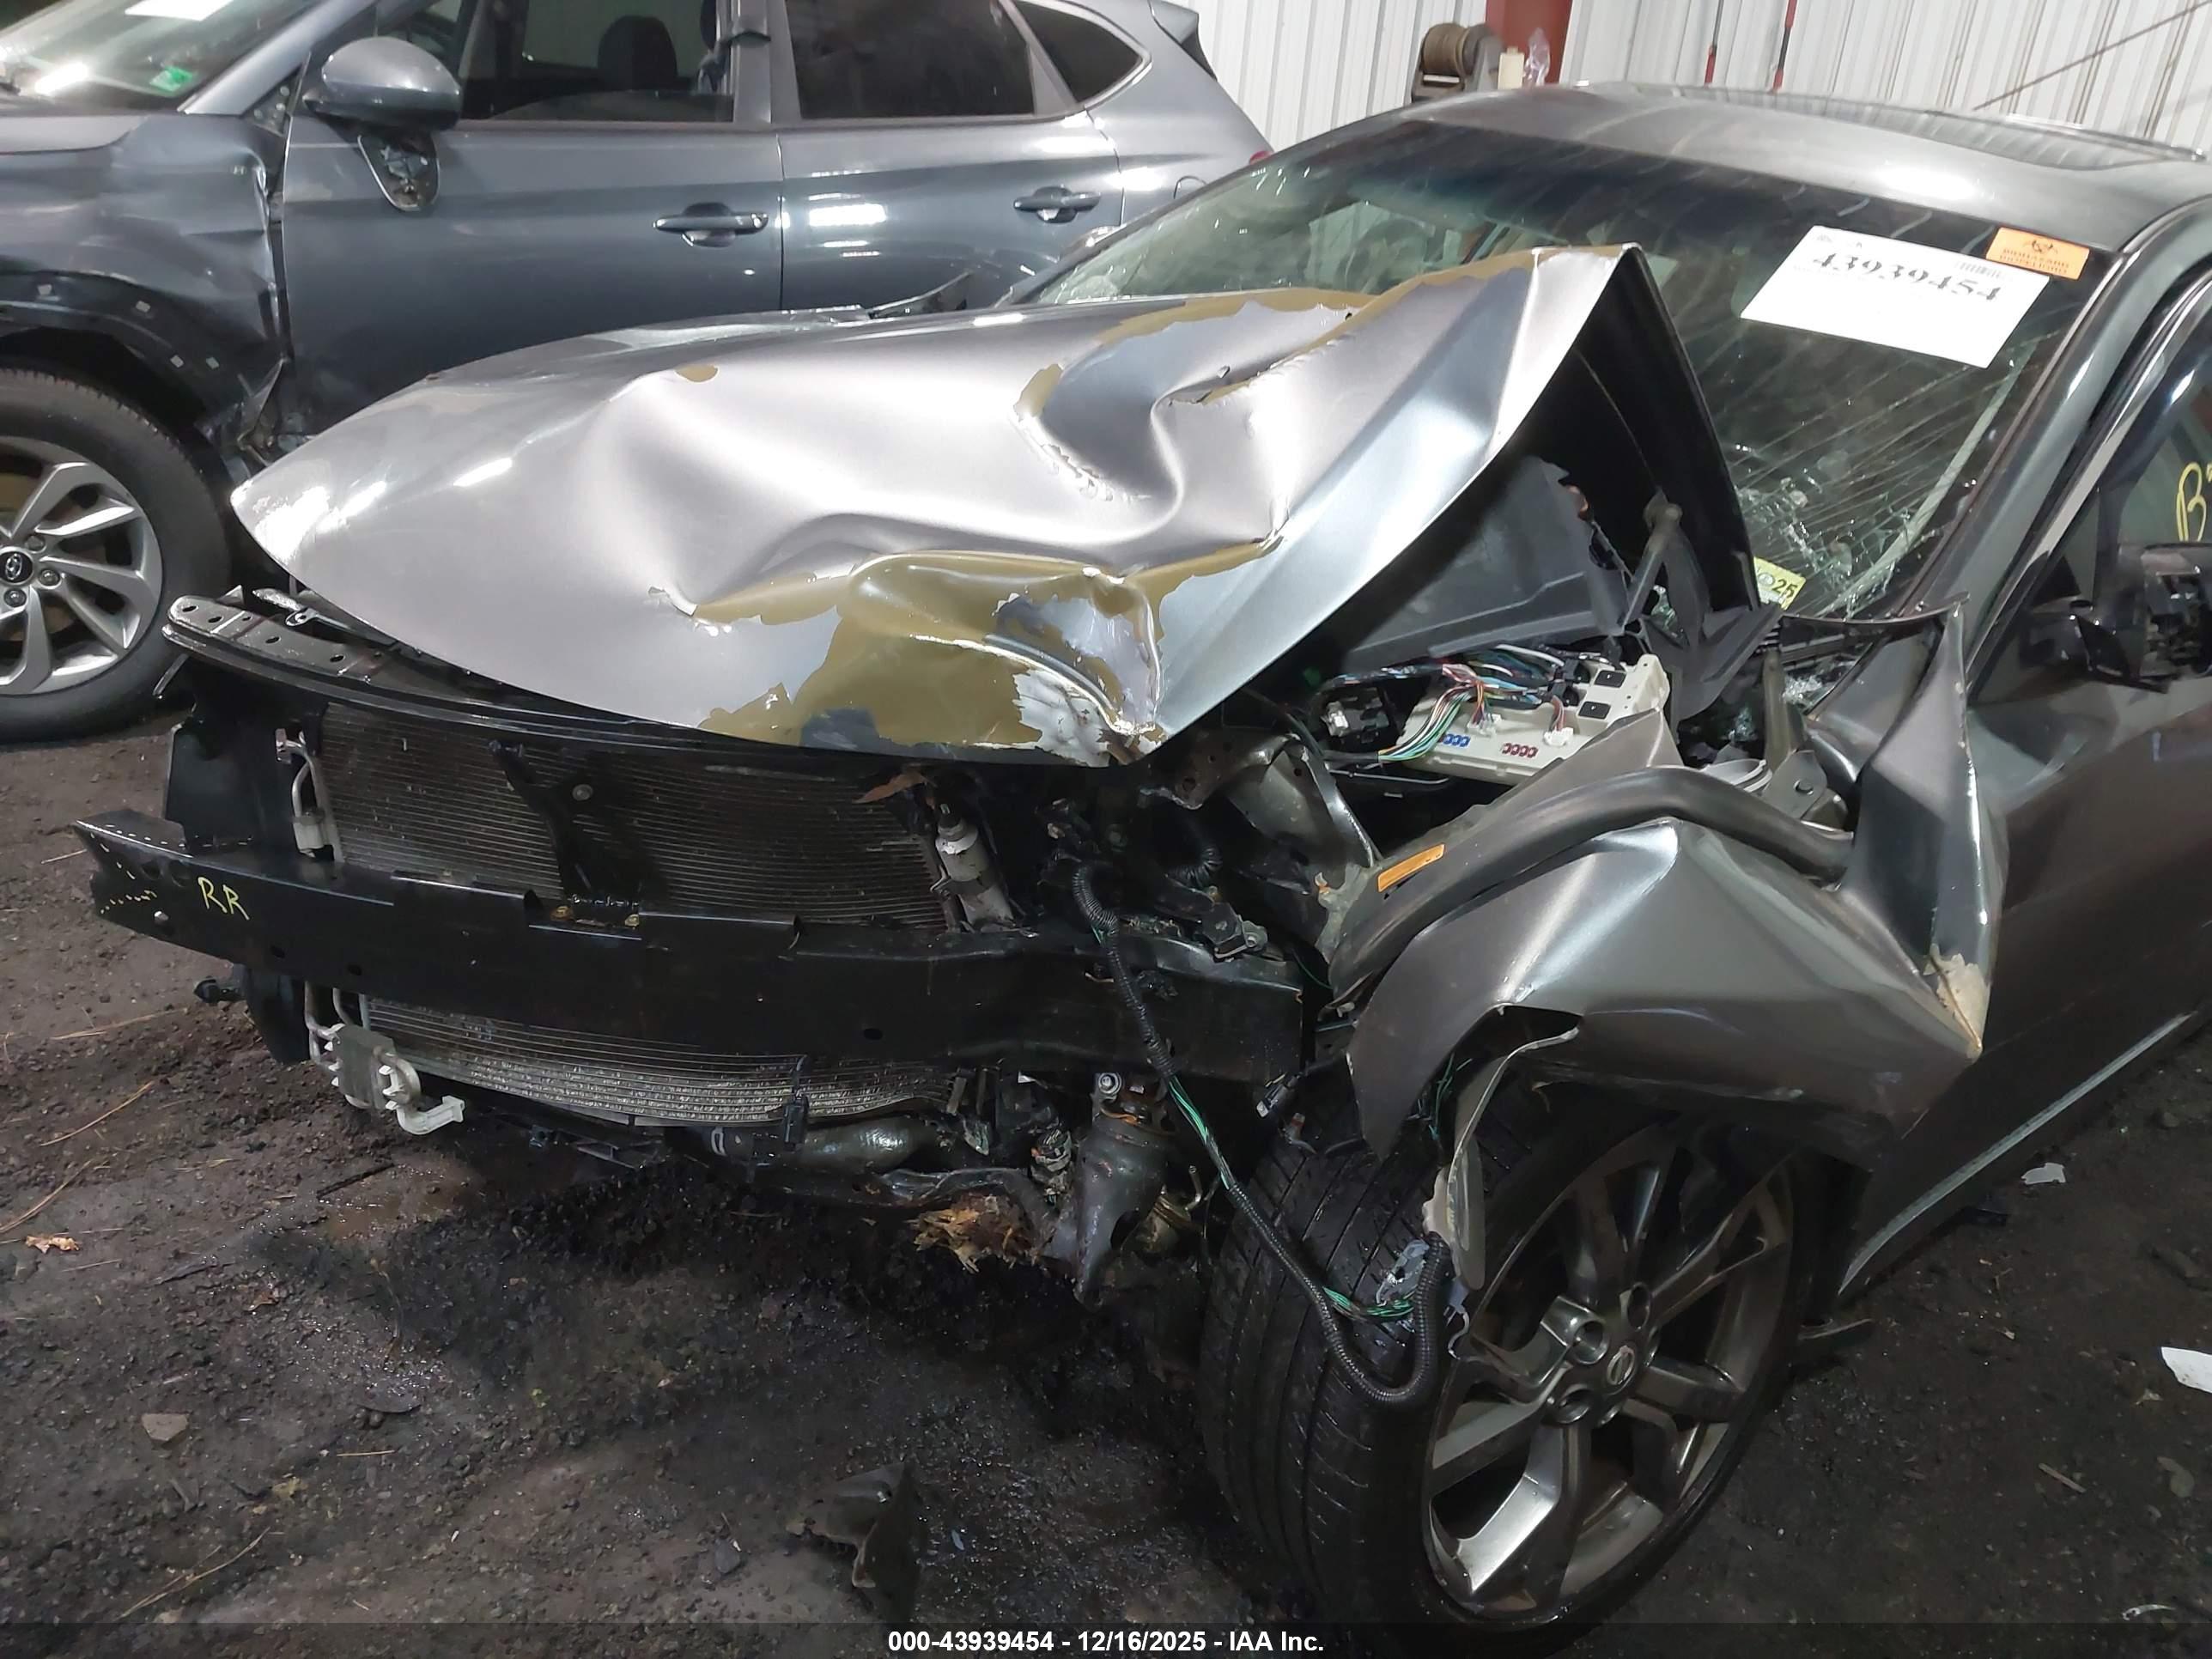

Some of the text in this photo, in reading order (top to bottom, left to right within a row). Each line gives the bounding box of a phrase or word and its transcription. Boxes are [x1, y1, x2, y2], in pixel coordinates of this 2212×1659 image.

[1812, 252, 2002, 301] 43939454
[1771, 578, 1799, 599] 25
[197, 875, 252, 921] RR
